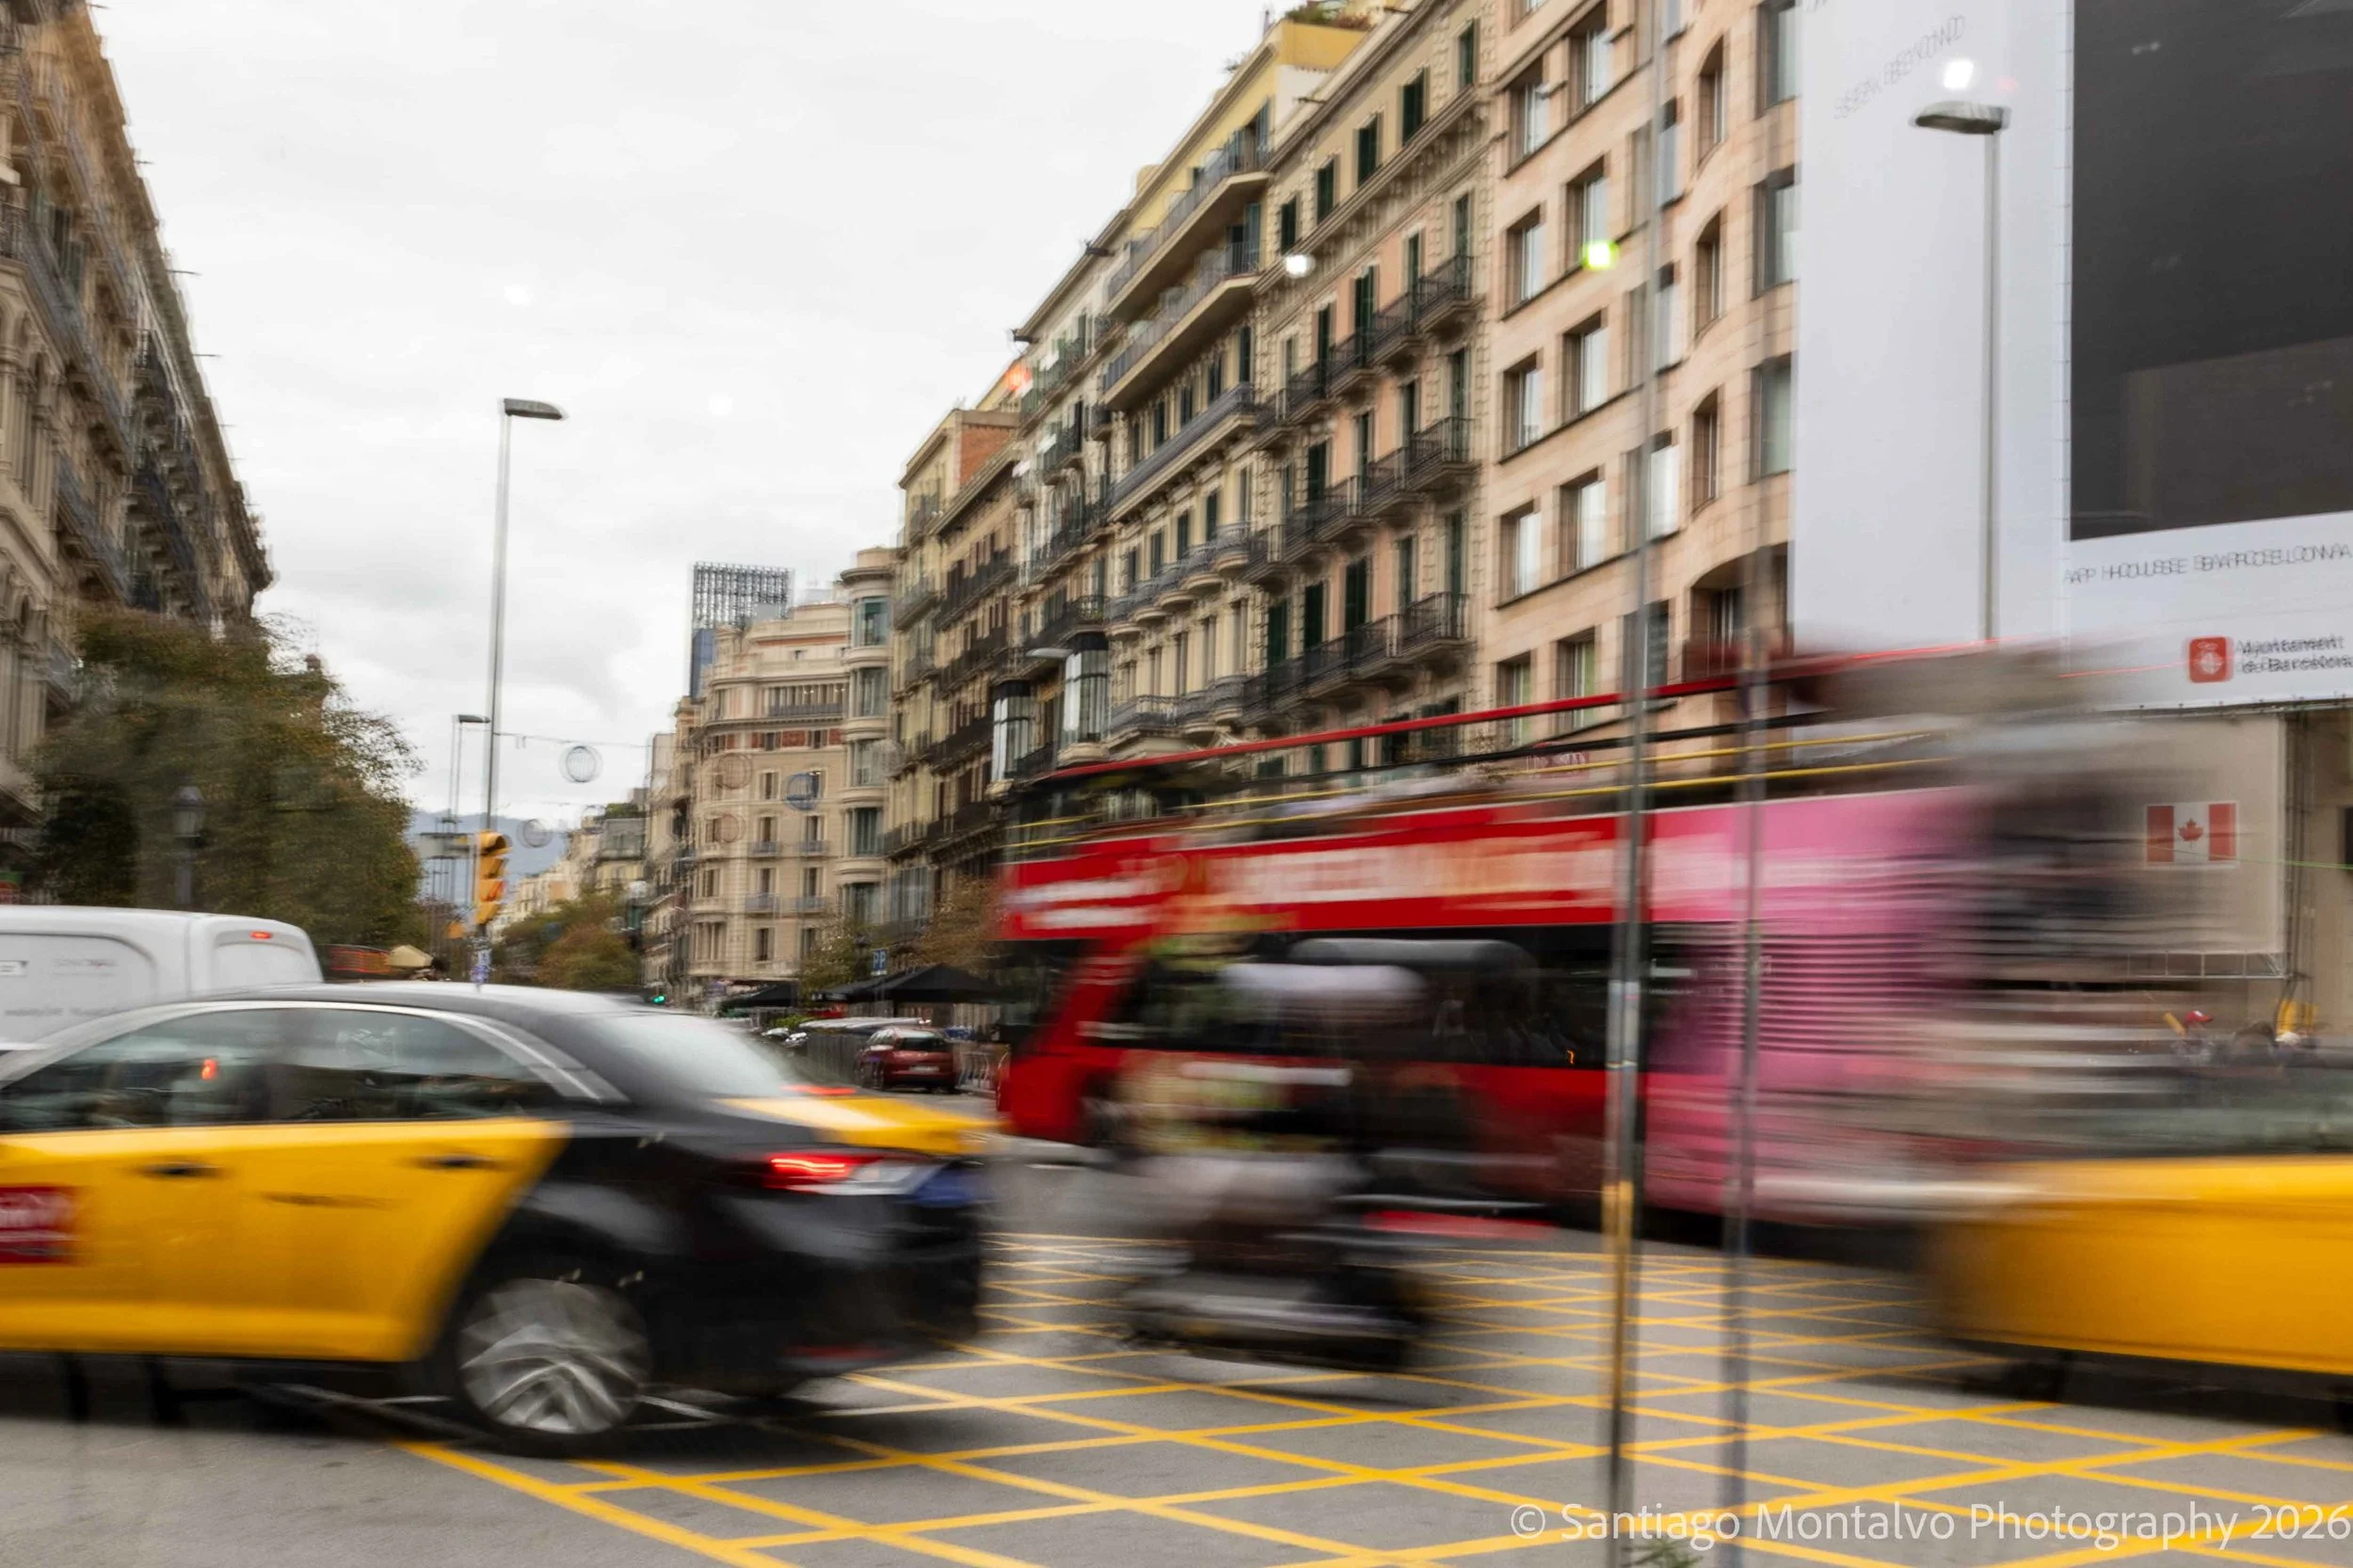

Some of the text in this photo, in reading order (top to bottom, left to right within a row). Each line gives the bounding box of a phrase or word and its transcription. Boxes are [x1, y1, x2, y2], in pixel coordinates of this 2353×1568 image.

[2102, 557, 2188, 580] HOUSE
[2194, 542, 2352, 571] BARCELONA
[2236, 634, 2345, 658] Ajuntament
